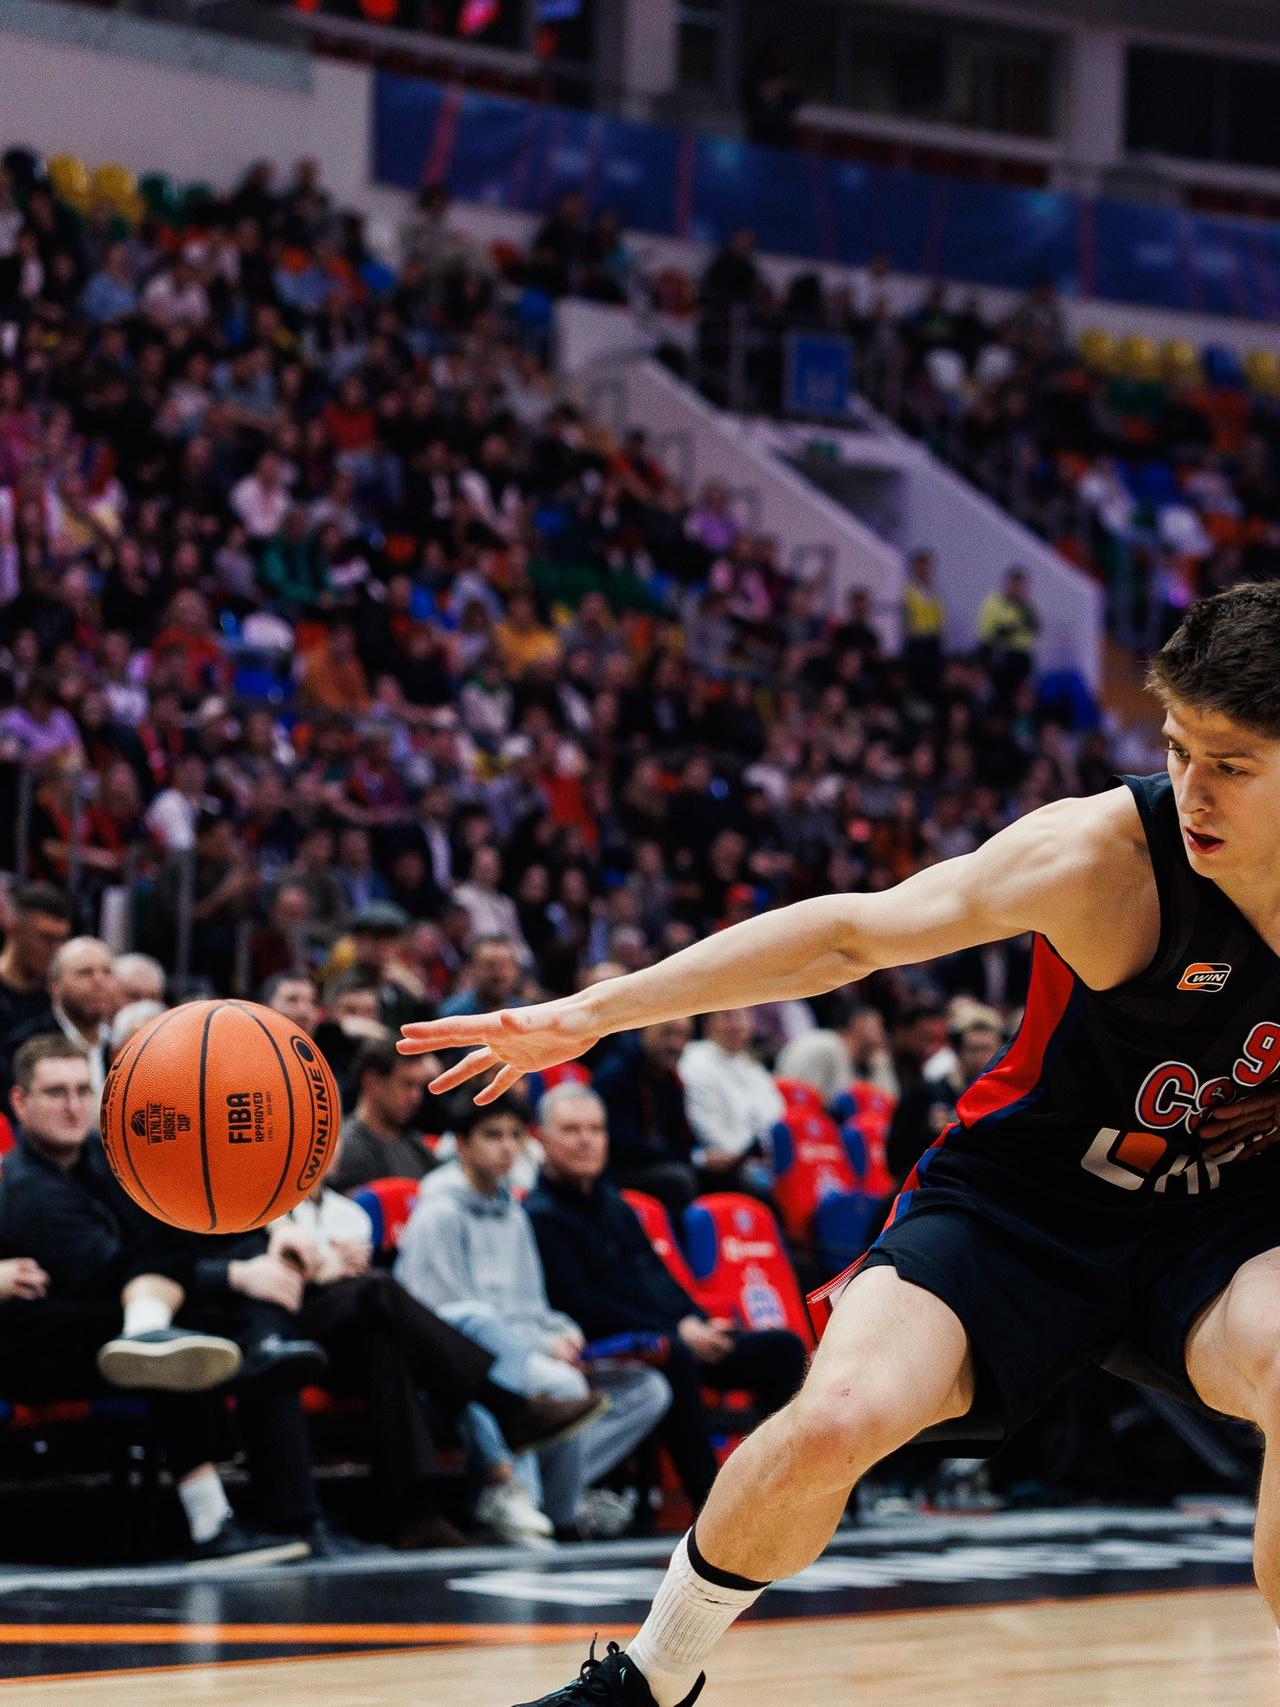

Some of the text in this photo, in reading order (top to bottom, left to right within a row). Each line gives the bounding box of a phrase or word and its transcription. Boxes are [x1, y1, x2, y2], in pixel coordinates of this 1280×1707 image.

[1192, 973, 1226, 983] WIN
[150, 1103, 162, 1143] WINLINE
[163, 1106, 176, 1140] BASKET
[177, 1114, 191, 1132] CUP
[226, 1092, 252, 1144] FIBA
[253, 1092, 265, 1142] APPROVED
[304, 1067, 329, 1179] WINLINE
